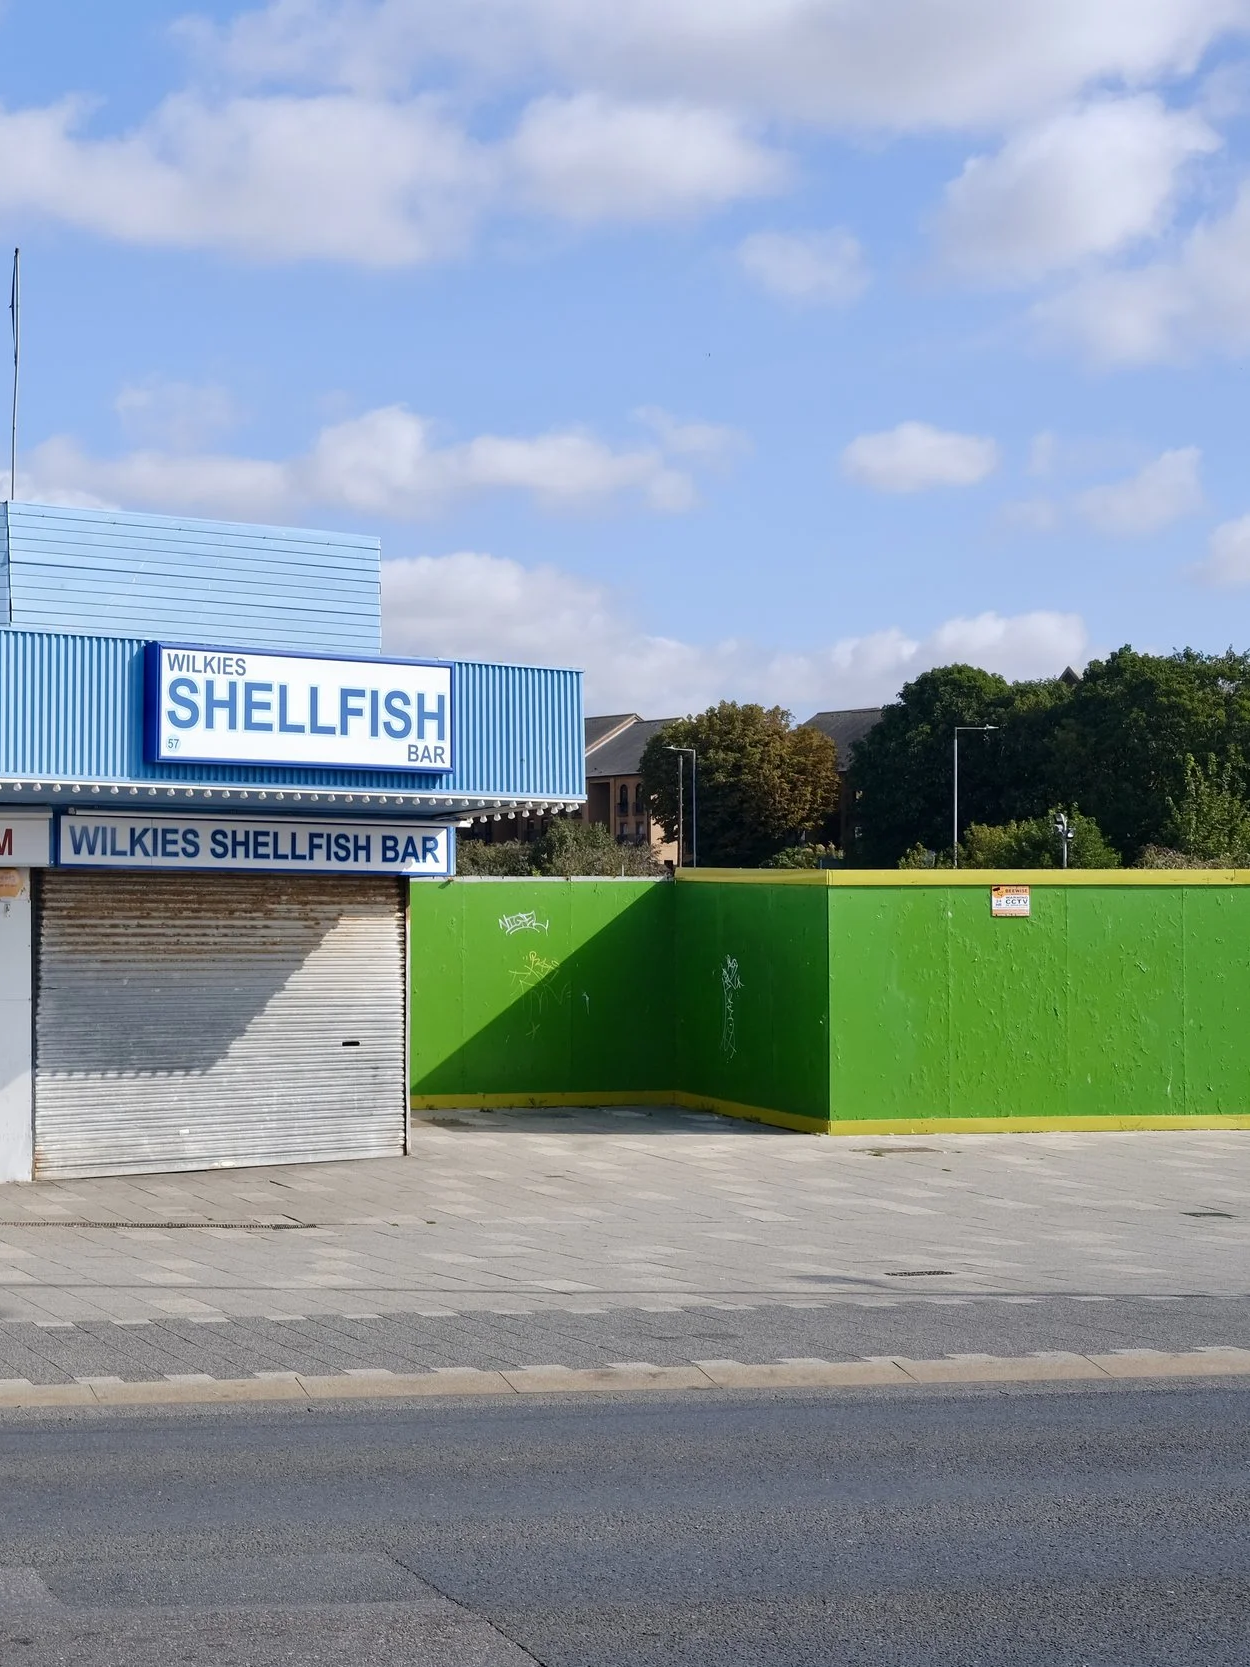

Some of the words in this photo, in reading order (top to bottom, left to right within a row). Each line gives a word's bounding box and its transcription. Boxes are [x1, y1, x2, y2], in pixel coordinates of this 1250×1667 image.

[167, 653, 247, 676] WILKIES
[166, 677, 446, 741] SHELLFISH
[167, 738, 180, 750] 57
[407, 744, 446, 764] BAR
[69, 825, 200, 858] WILKIES
[209, 829, 371, 862] SHELLFISH
[381, 835, 440, 864] BAR
